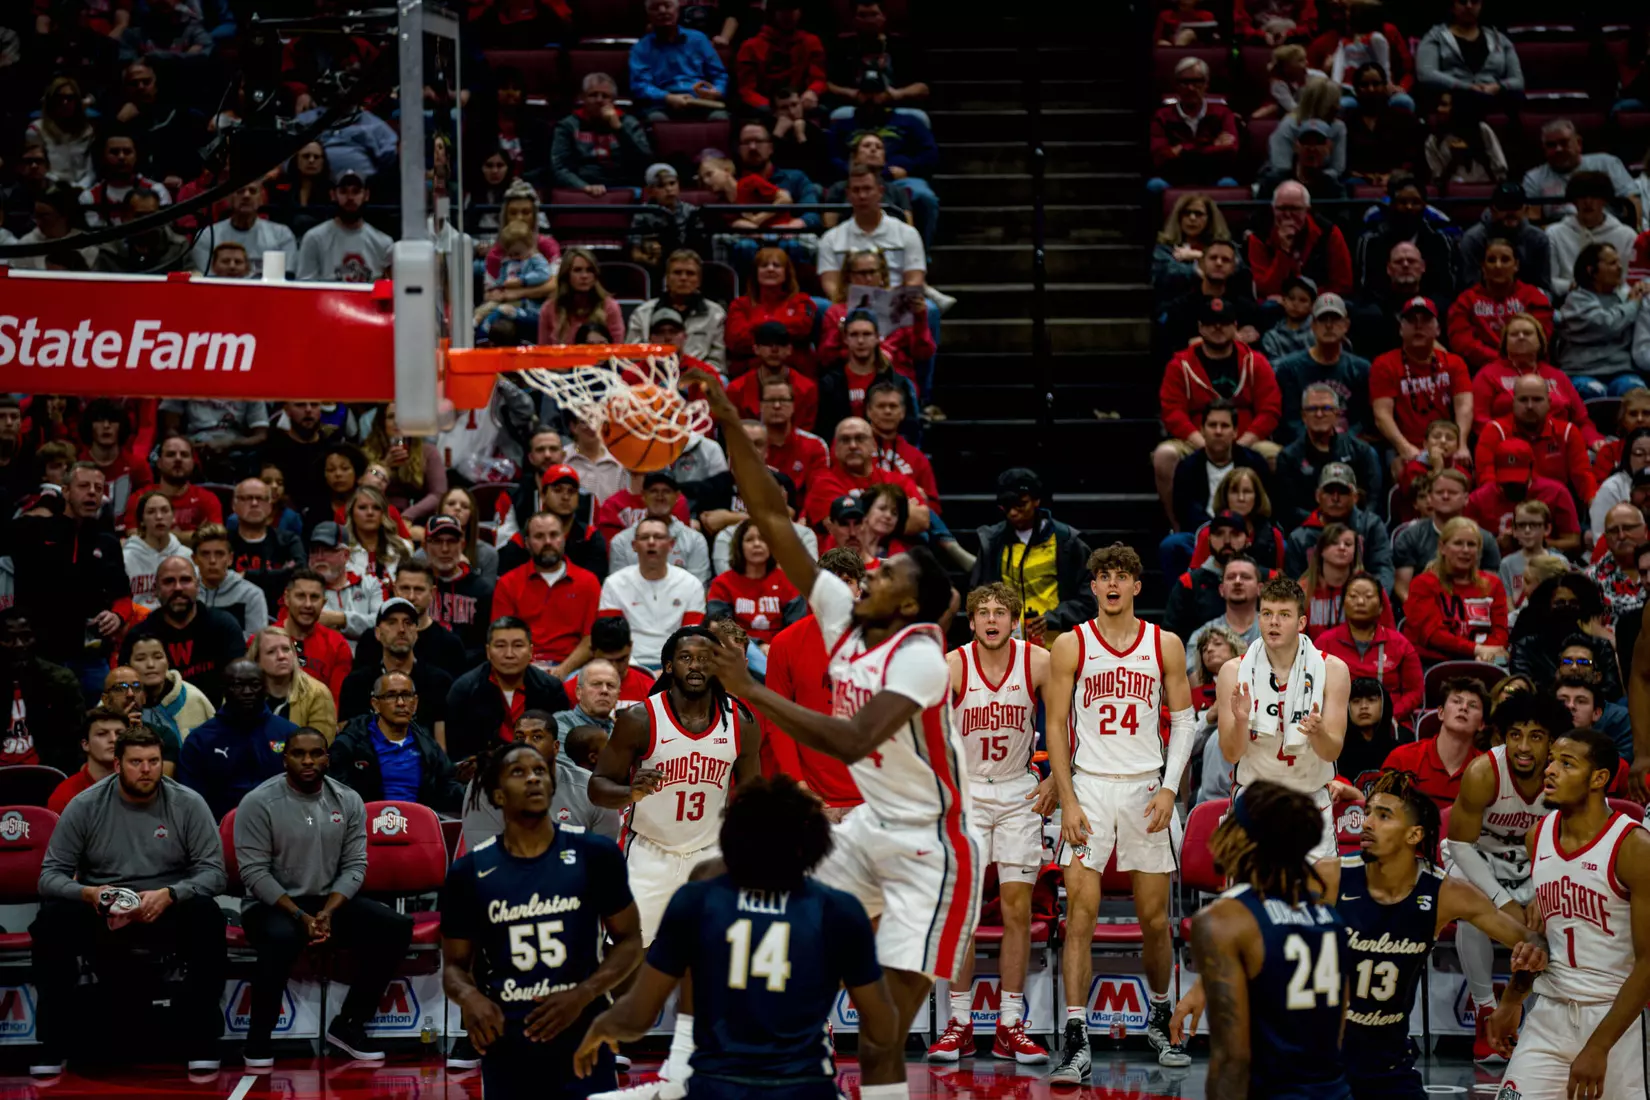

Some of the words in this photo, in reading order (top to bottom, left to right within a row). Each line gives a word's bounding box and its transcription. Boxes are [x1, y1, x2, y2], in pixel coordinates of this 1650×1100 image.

[1100, 704, 1139, 735] 24
[980, 735, 1008, 761] 15
[675, 791, 706, 821] 13
[488, 892, 582, 925] Charleston
[737, 887, 792, 915] KELLY
[508, 919, 568, 973] 55
[725, 918, 792, 993] 14
[1563, 927, 1577, 968] 1
[1283, 930, 1342, 1011] 24
[1356, 958, 1400, 1002] 13
